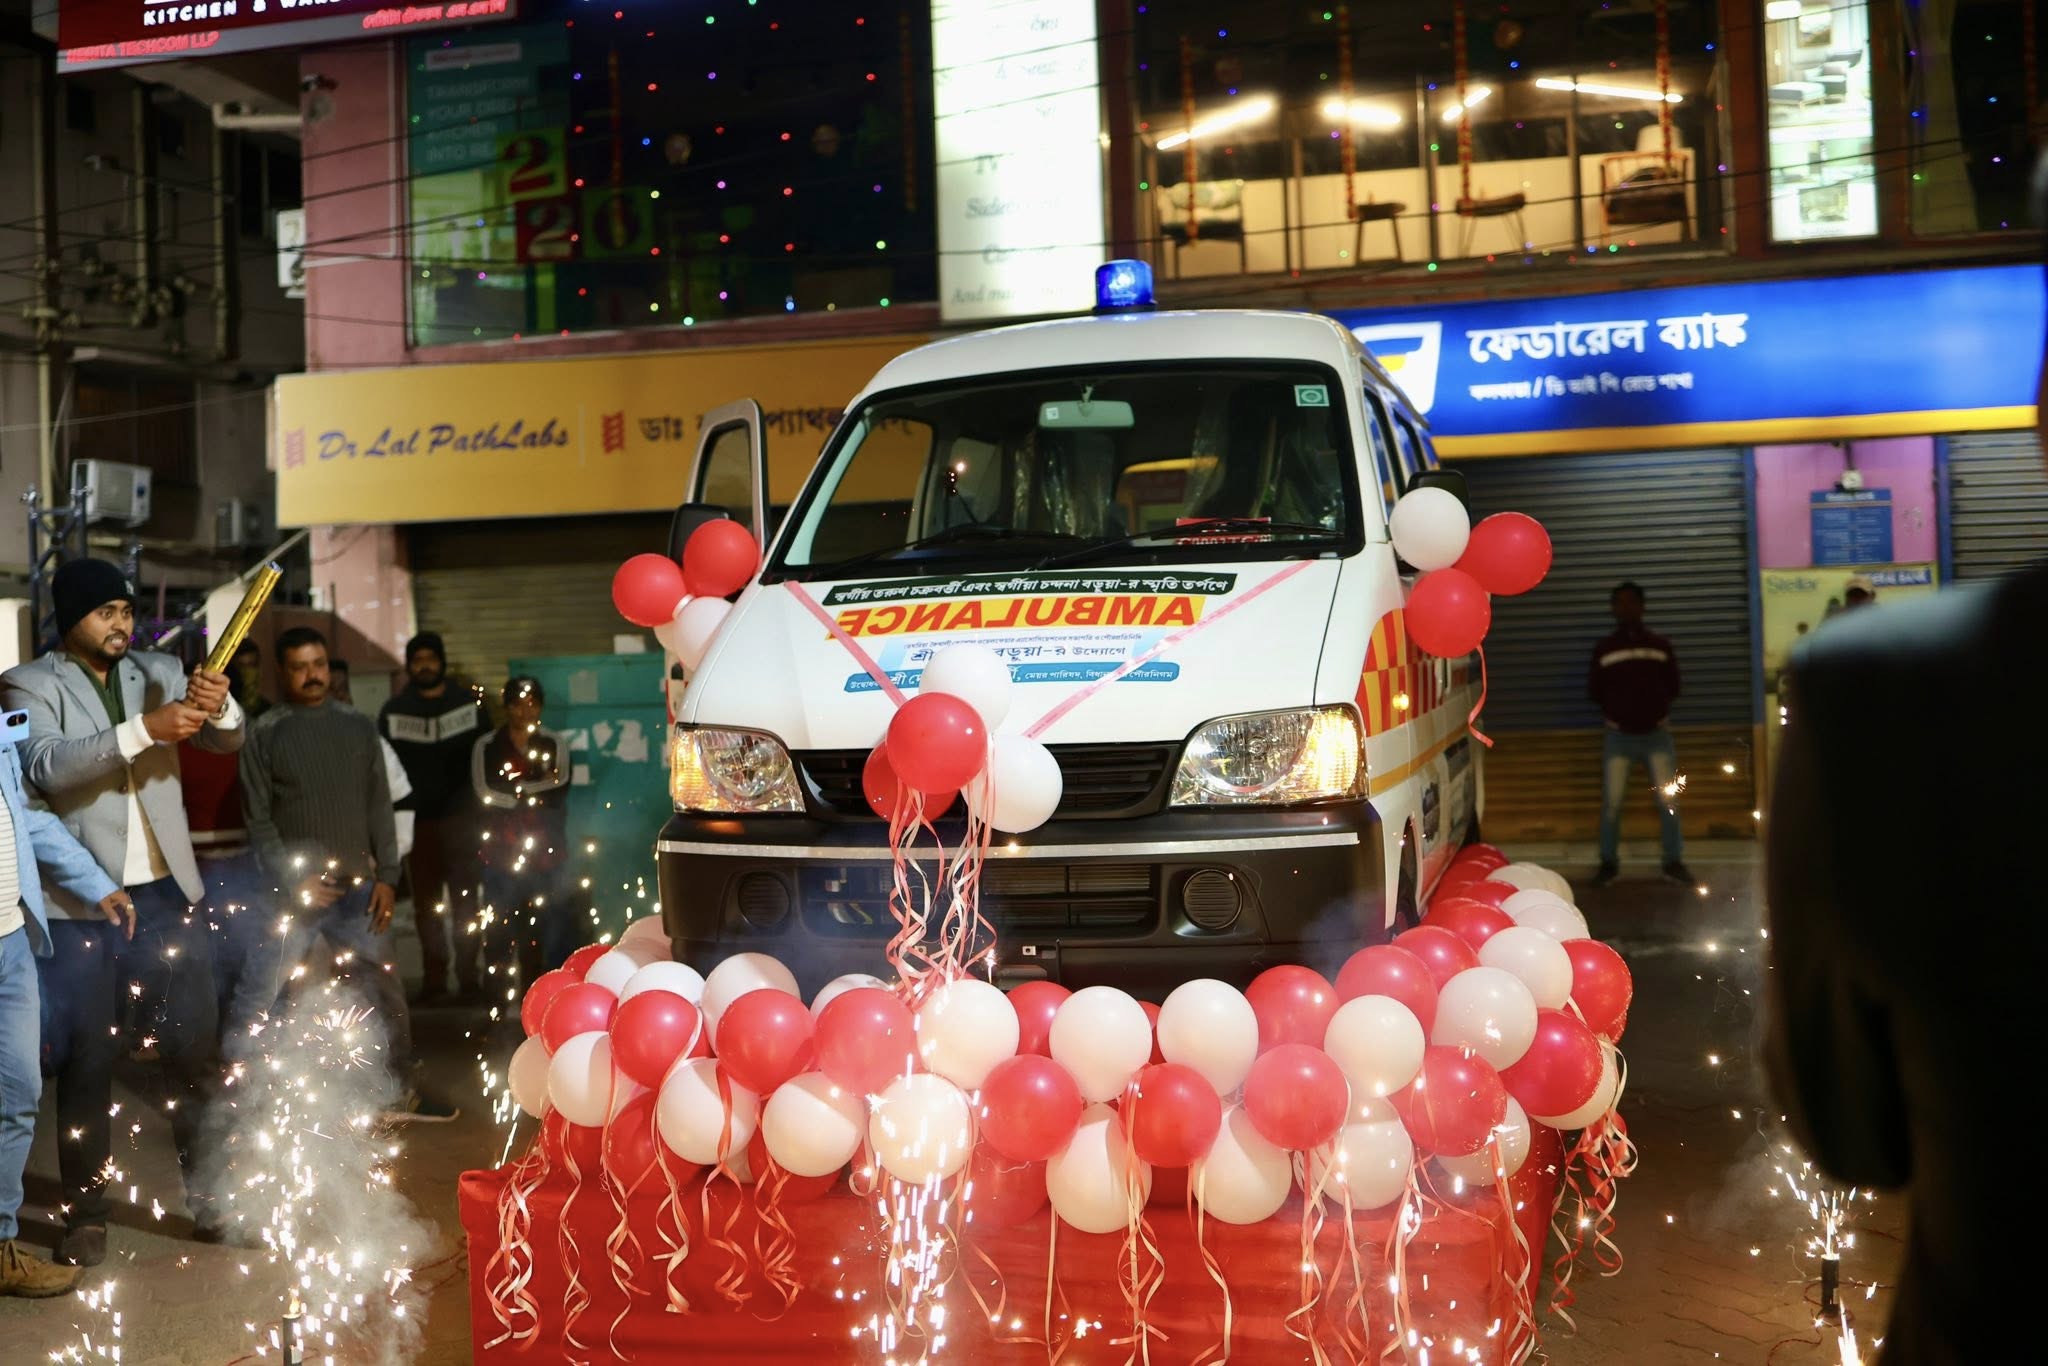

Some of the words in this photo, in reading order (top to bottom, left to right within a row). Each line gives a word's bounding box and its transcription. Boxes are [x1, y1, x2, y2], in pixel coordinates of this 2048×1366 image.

[143, 1, 237, 26] KITCHEN
[190, 31, 221, 49] LLP
[1465, 320, 1649, 363] ফেডারেল
[1656, 312, 1749, 350] ব্যাঙ্ক
[318, 430, 356, 460] Dr
[363, 427, 420, 457] Lal
[962, 582, 991, 593] এবং
[1040, 578, 1081, 590] চন্দনা
[1182, 577, 1229, 591] তর্পণে
